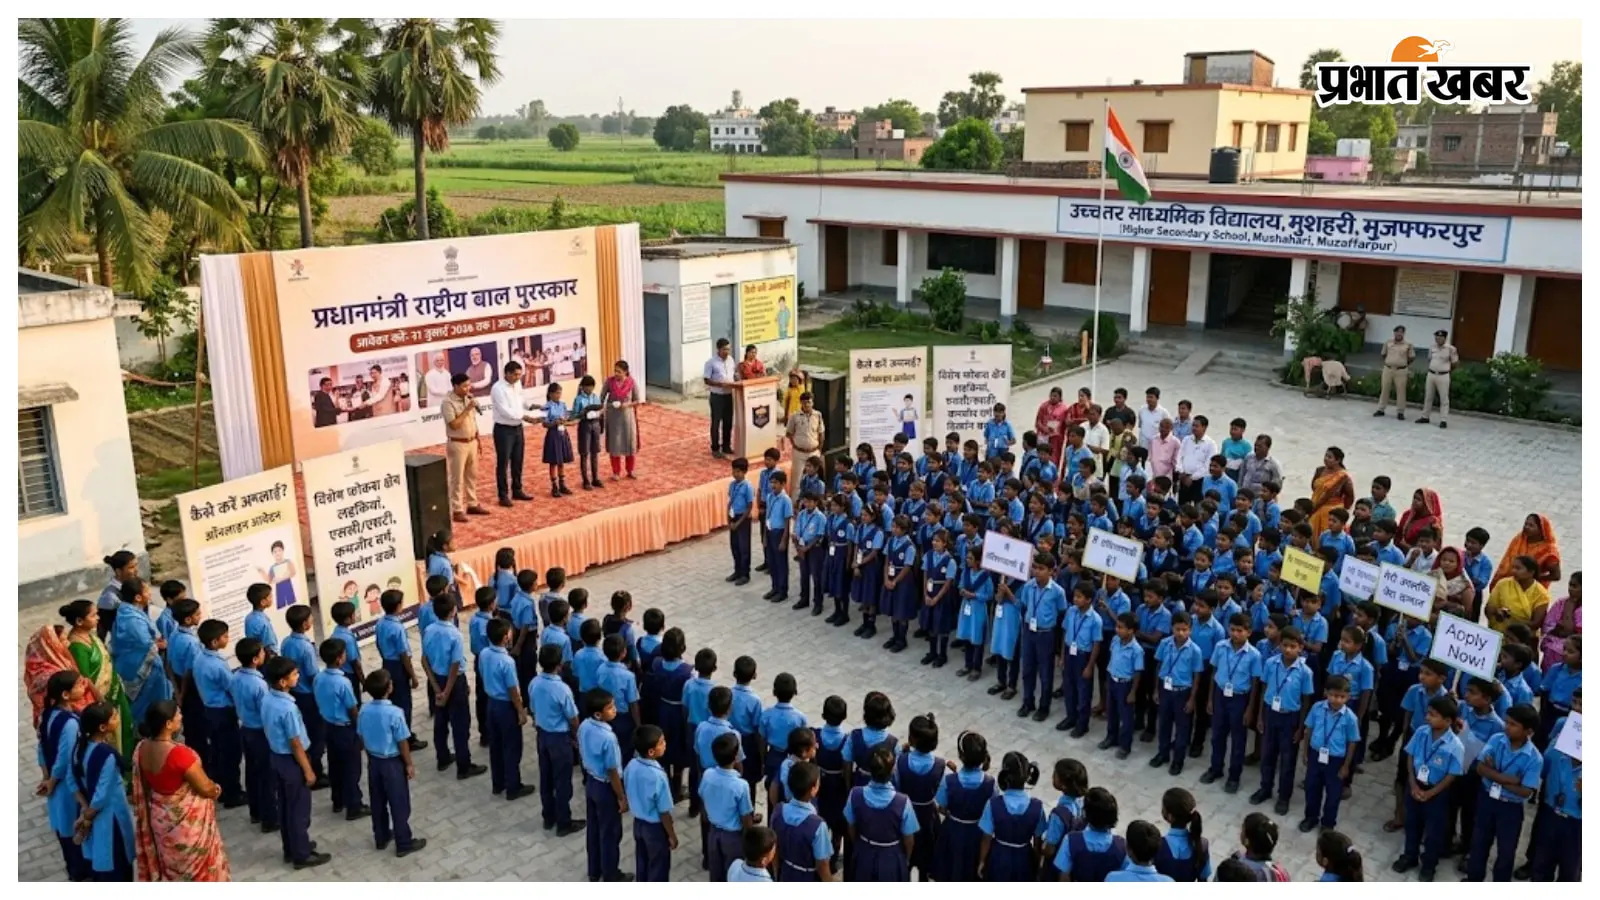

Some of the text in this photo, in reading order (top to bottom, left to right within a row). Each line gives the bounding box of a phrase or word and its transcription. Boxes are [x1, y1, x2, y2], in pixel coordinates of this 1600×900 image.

[1157, 227, 1209, 241] Secondary
[1213, 229, 1251, 242] School,
[312, 279, 578, 328] प्रधानमंत्री राष्ट्रीय बाल पुरस्कार
[1447, 644, 1486, 671] Now!
